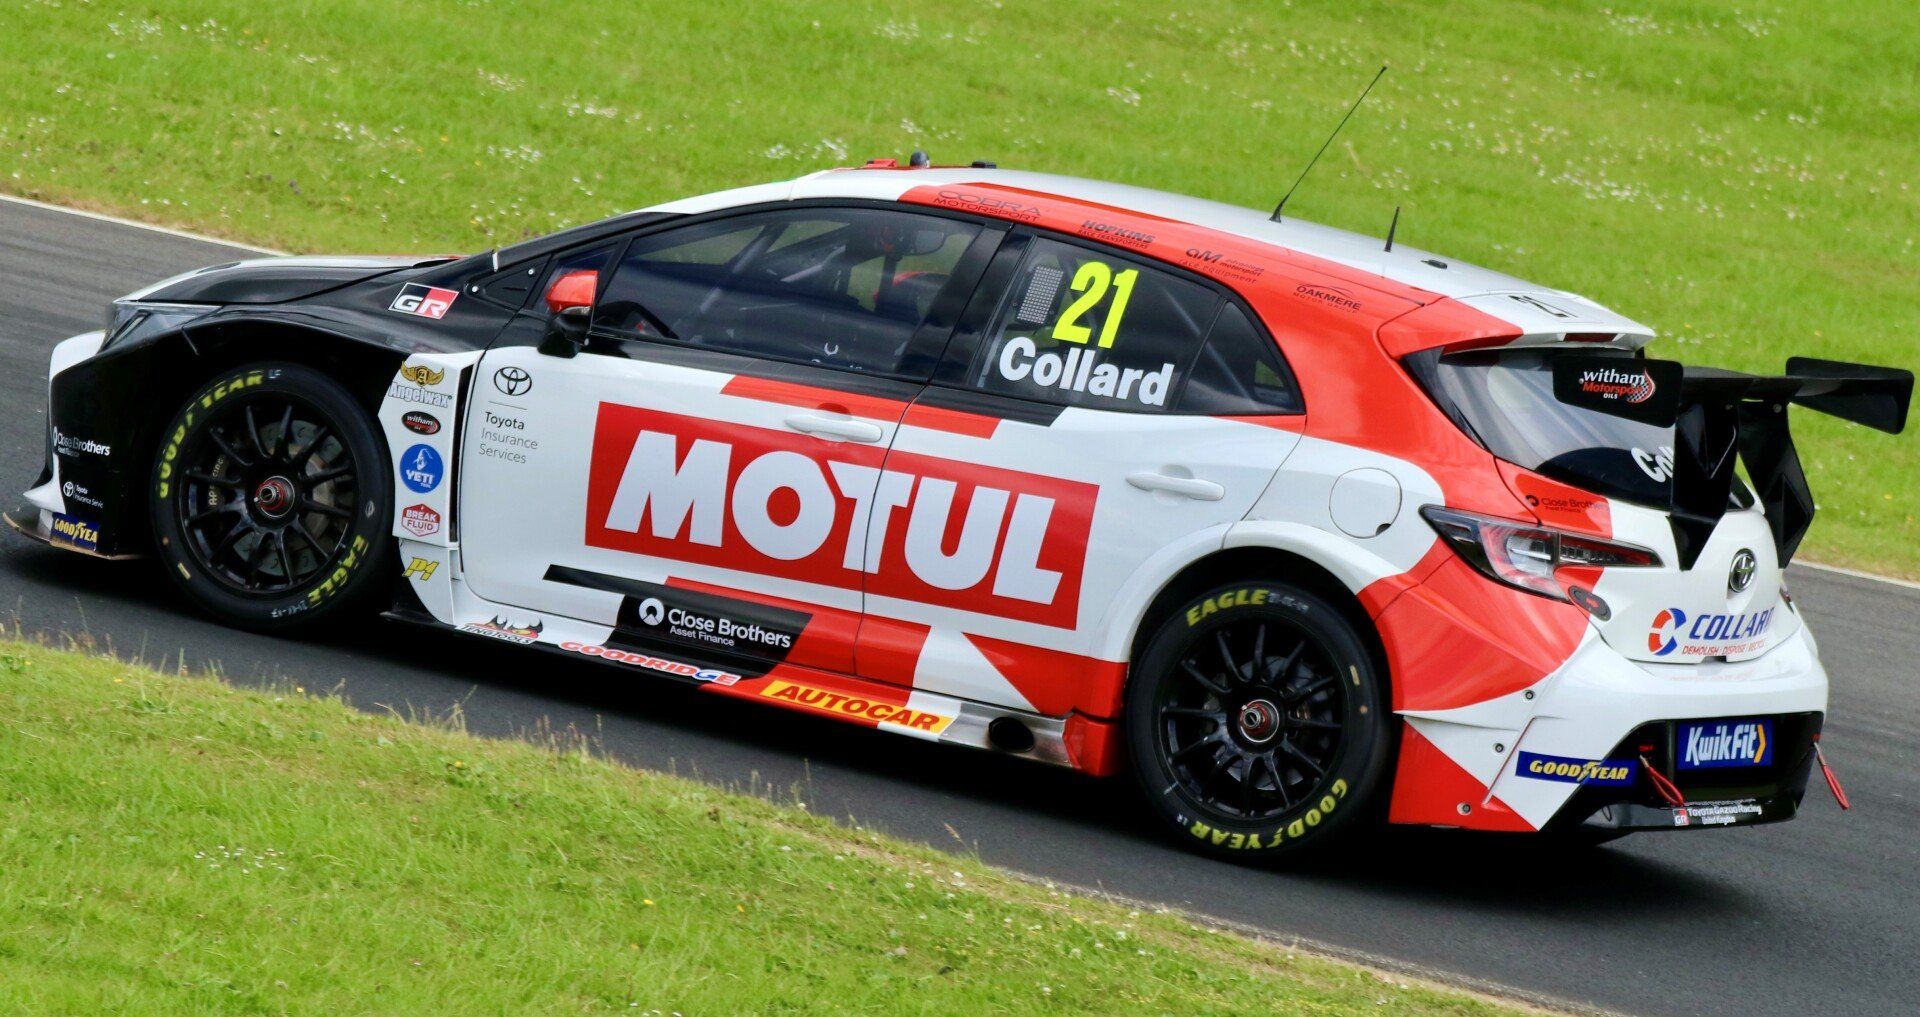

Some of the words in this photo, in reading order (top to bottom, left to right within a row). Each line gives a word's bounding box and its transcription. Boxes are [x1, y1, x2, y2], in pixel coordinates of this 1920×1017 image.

[933, 197, 1040, 222] MOTORSPORT
[1081, 220, 1156, 243] HOPKINS
[1203, 265, 1257, 284] equipment
[1220, 262, 1262, 277] motorsport
[394, 295, 447, 317] GR
[1052, 261, 1139, 349] 21
[1296, 284, 1363, 311] OAKMERE
[999, 336, 1175, 407] Collard
[1583, 368, 1645, 387] witham
[388, 382, 448, 408] Angelwax
[485, 411, 525, 430] Toyota
[72, 437, 111, 456] Brothers
[481, 428, 538, 450] Insurance
[479, 443, 527, 464] Services
[1630, 446, 1673, 482] Coll
[406, 469, 434, 485] YETI
[91, 497, 104, 508] Servic
[406, 509, 437, 523] BREAK
[407, 519, 434, 531] FLUID
[604, 430, 1063, 605] MOTUL
[54, 518, 99, 543] GOODYEA
[402, 556, 440, 581] P1
[1186, 589, 1270, 627] EAGLE
[667, 608, 715, 632] Close
[718, 619, 791, 648] Brothers
[669, 625, 696, 639] Asset
[698, 631, 735, 647] Finance
[1682, 645, 1719, 656] DEMOLISH
[559, 641, 741, 685] GOODRIDGE
[774, 685, 940, 732] AUTOCAR
[1529, 760, 1629, 782] GOODYEAR
[1190, 778, 1349, 850] GOODYEAR
[1674, 815, 1688, 826] GR
